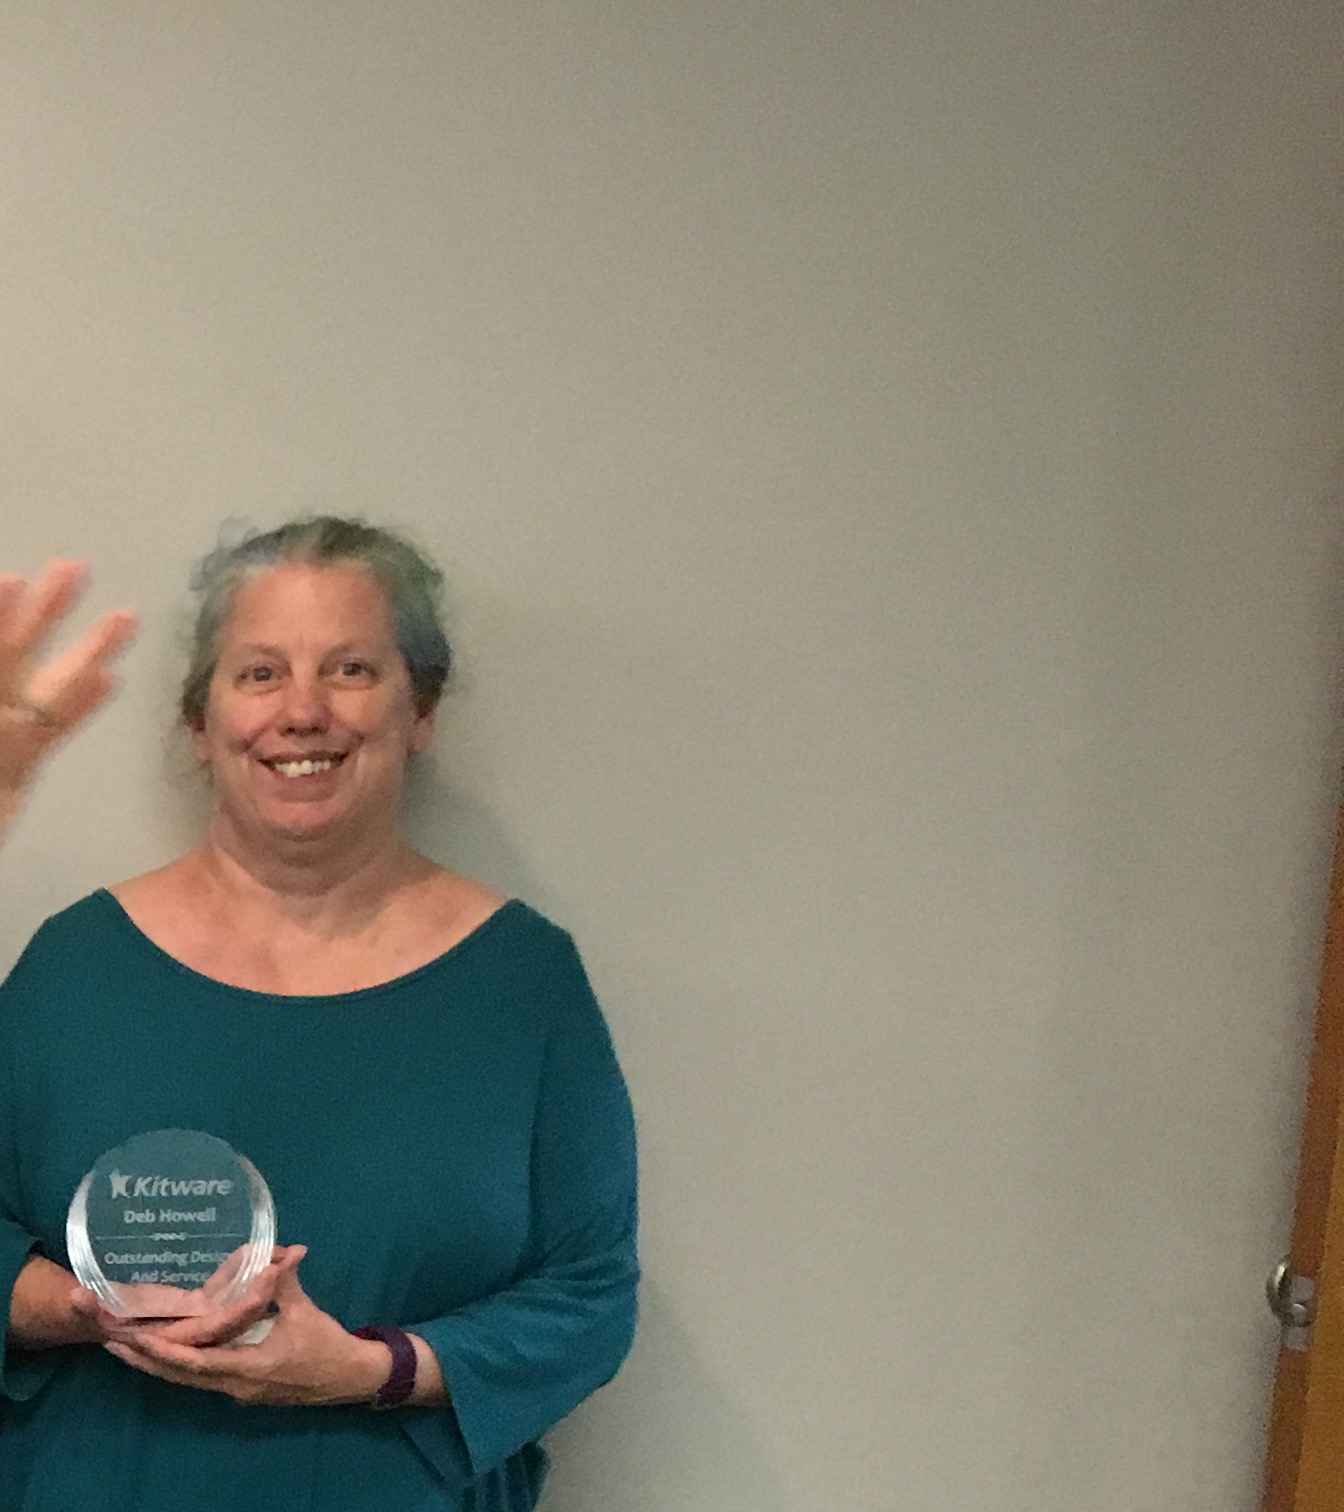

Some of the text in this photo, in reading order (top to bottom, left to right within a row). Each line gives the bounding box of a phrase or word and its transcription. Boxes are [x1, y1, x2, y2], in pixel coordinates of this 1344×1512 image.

[132, 1174, 235, 1198] Kitware
[123, 1206, 217, 1224] Deb Howell
[103, 1250, 190, 1267] Outstanding
[129, 1269, 159, 1283] And
